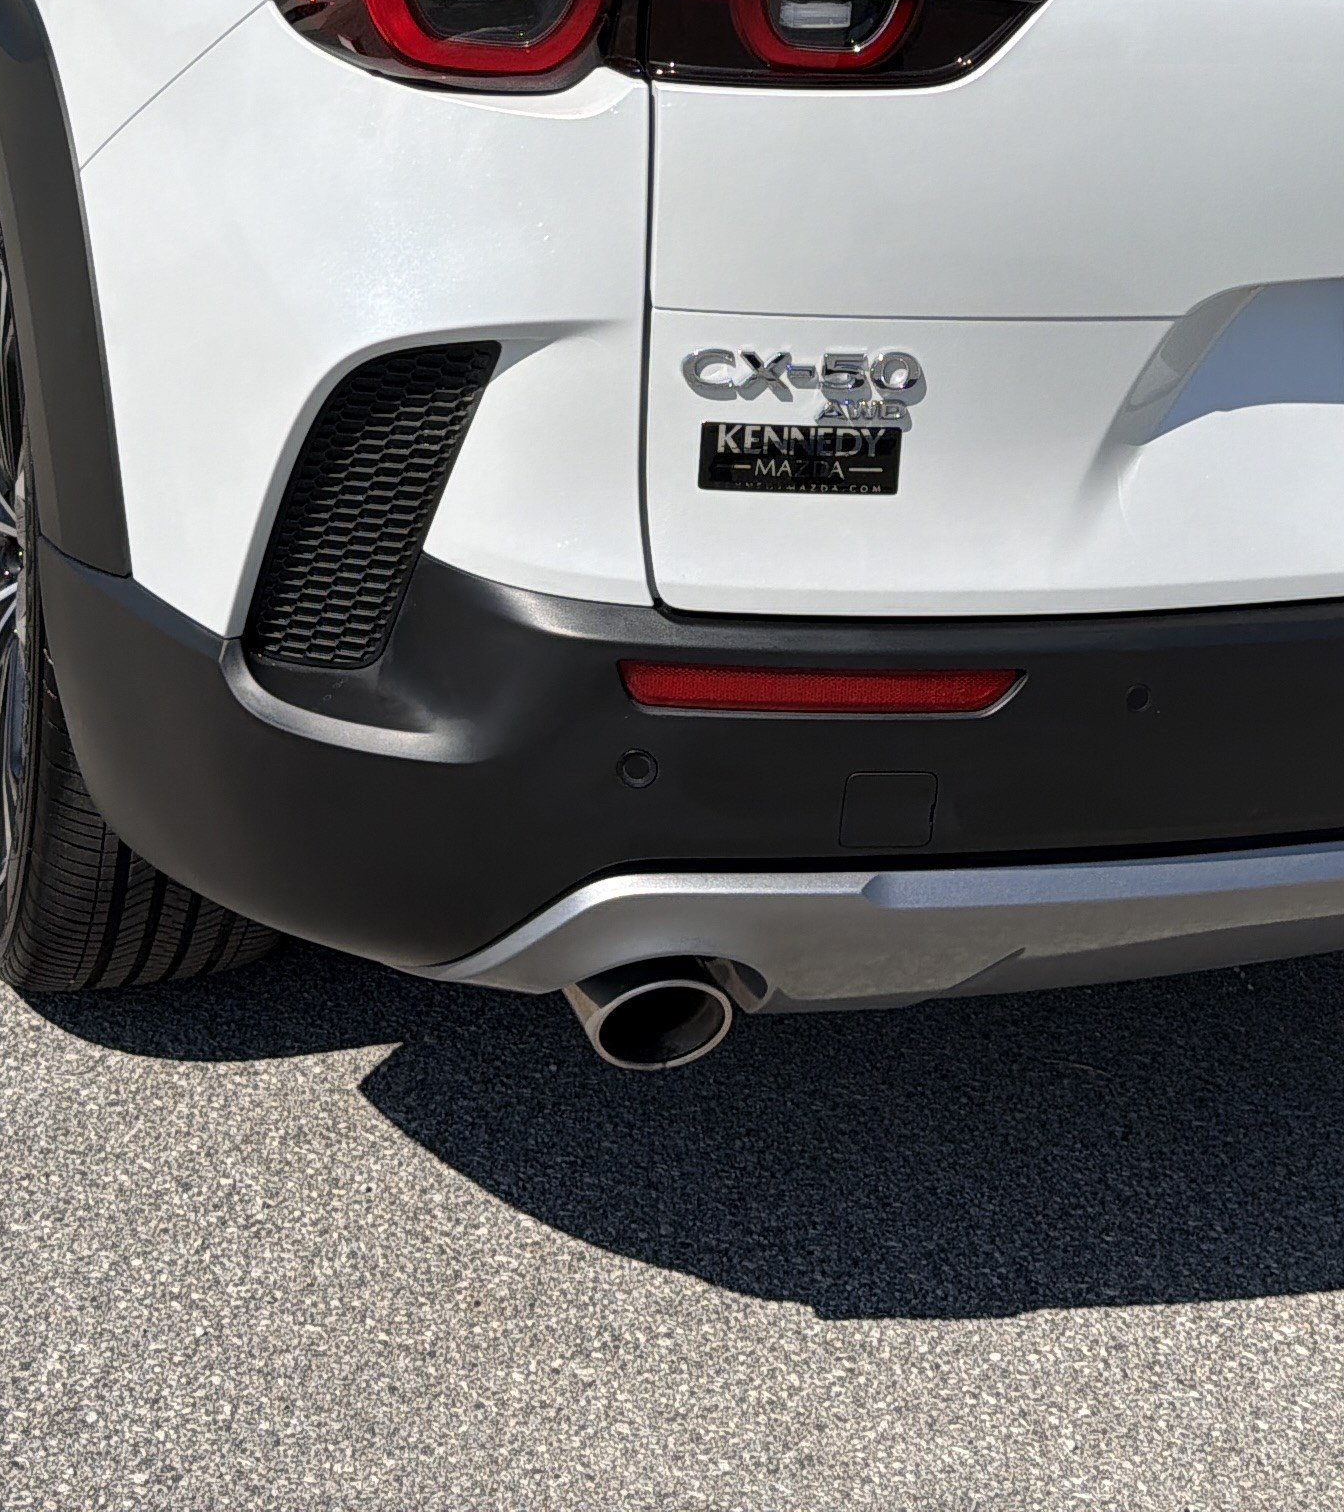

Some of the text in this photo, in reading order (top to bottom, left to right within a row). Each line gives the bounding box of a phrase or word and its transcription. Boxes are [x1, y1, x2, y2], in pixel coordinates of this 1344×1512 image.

[681, 348, 924, 398] CX-50
[717, 424, 886, 458] KENNEDY
[754, 458, 845, 481] MAZDA
